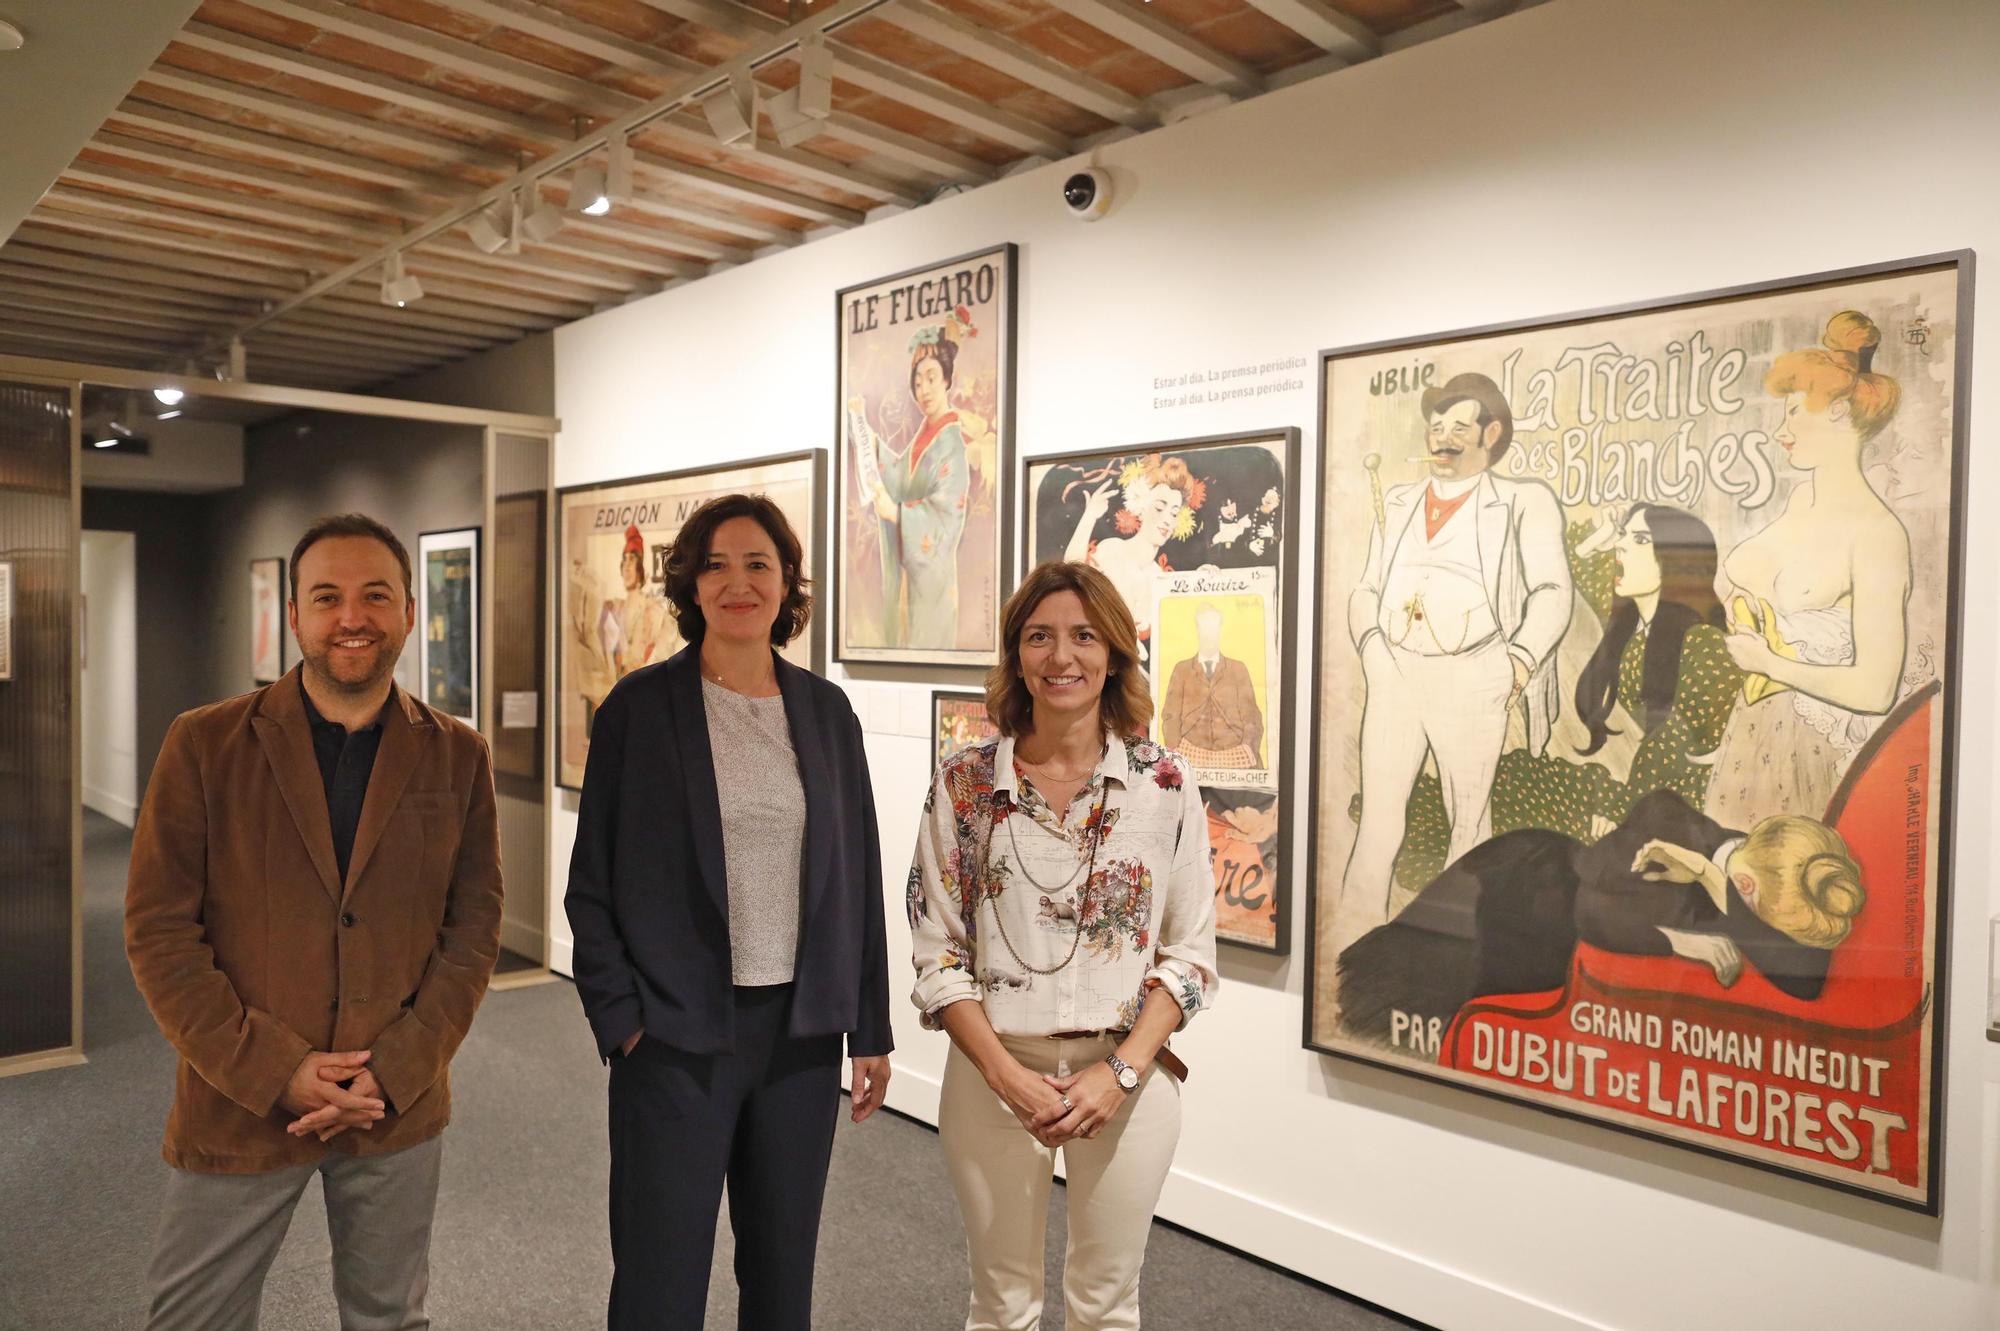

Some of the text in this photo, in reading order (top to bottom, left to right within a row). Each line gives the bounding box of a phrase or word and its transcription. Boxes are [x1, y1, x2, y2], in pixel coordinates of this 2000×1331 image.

[852, 264, 994, 334] LE FIGARO
[1153, 397, 1176, 410] Estar
[1179, 393, 1187, 407] al
[1208, 389, 1219, 402] La
[1222, 386, 1255, 402] prensa
[1154, 377, 1177, 390] Estar
[1179, 373, 1187, 387] al
[1208, 369, 1219, 382] La
[1222, 365, 1257, 382] premsa
[1502, 347, 1560, 432] La
[1509, 419, 1776, 510] des Blanches
[594, 501, 661, 528] EDICIÓN
[1170, 578, 1249, 593] Le Sourire
[1246, 772, 1268, 784] CHEF
[1570, 1001, 1891, 1097] GRAND ROMAN INEDIT
[1391, 1009, 1908, 1172] PAR DUBUT DE LAFOREST
